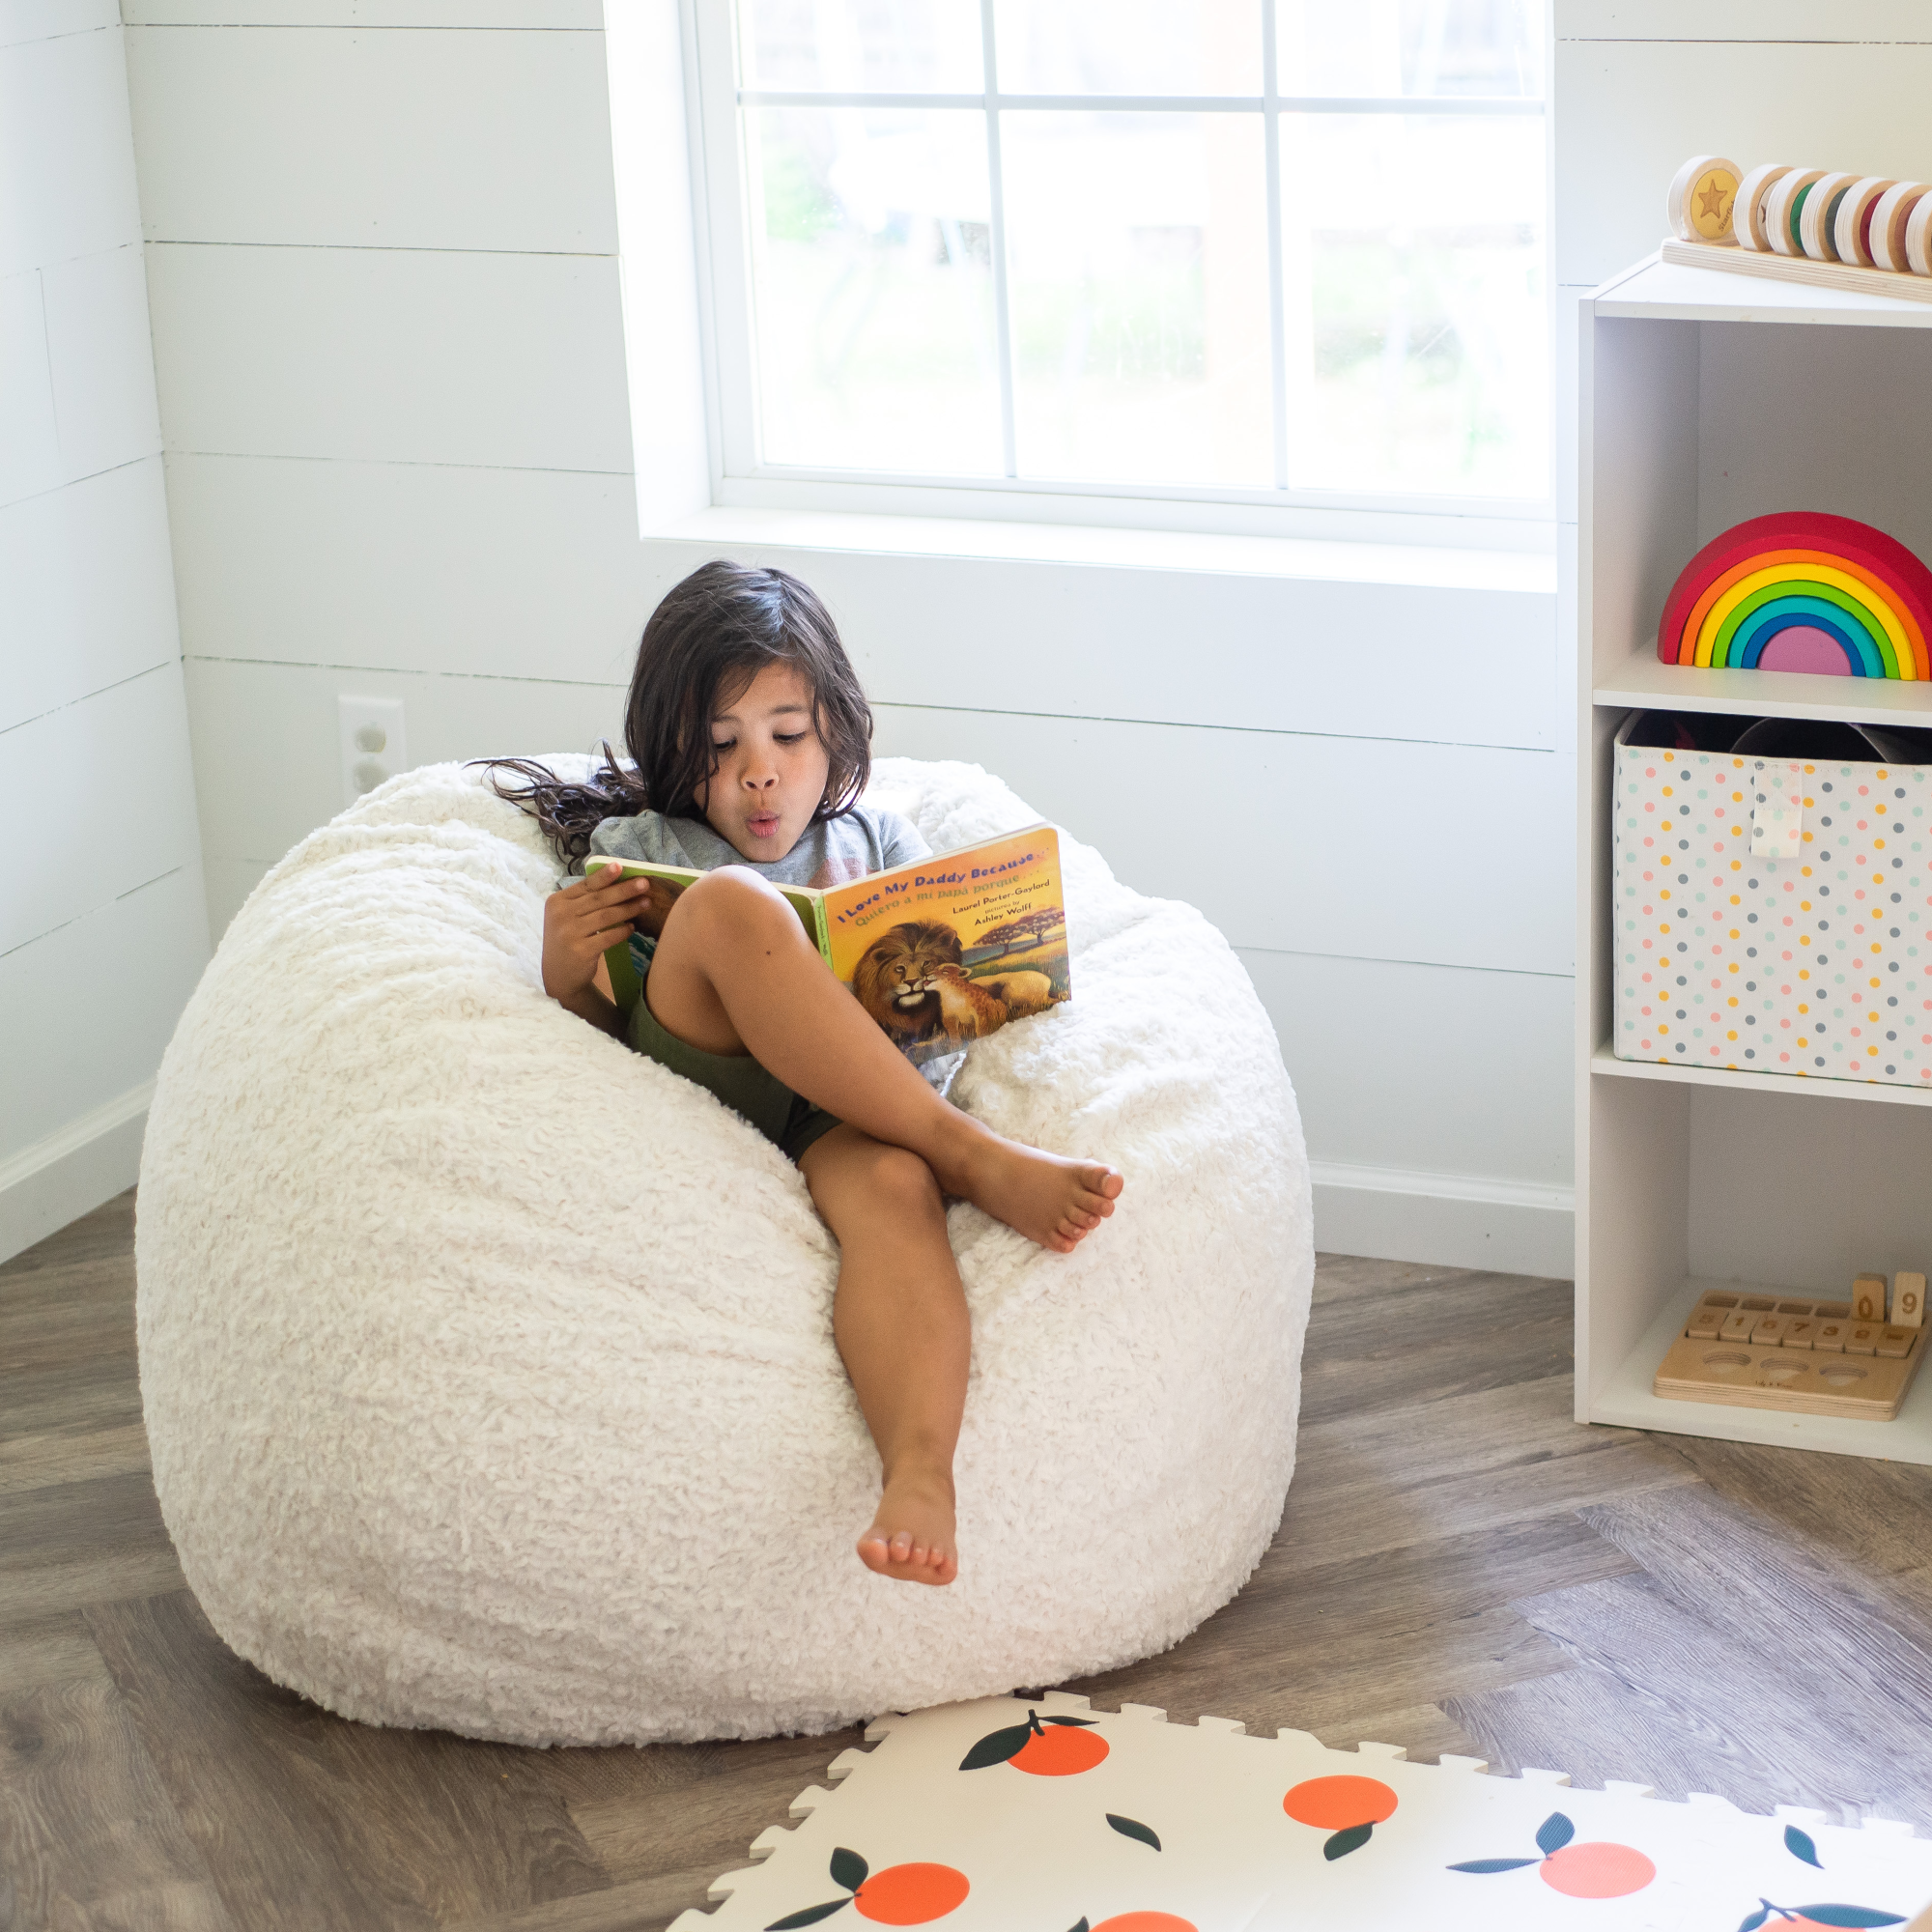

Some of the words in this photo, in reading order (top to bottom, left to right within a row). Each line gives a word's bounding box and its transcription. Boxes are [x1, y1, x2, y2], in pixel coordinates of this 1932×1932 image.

[837, 915, 846, 923] I
[844, 893, 881, 918] Love
[884, 881, 909, 895] My
[914, 871, 967, 887] Daddy
[855, 899, 900, 927] Quiero
[903, 895, 912, 905] a
[937, 885, 969, 900] papá
[952, 899, 980, 915] Laurel
[982, 878, 1050, 905] Porter-Gaylord
[974, 913, 1004, 926] Ashley
[1006, 901, 1033, 916] Wolff
[1858, 1295, 1874, 1320] 0
[1901, 1292, 1918, 1315] 9
[1794, 1321, 1810, 1333] 7
